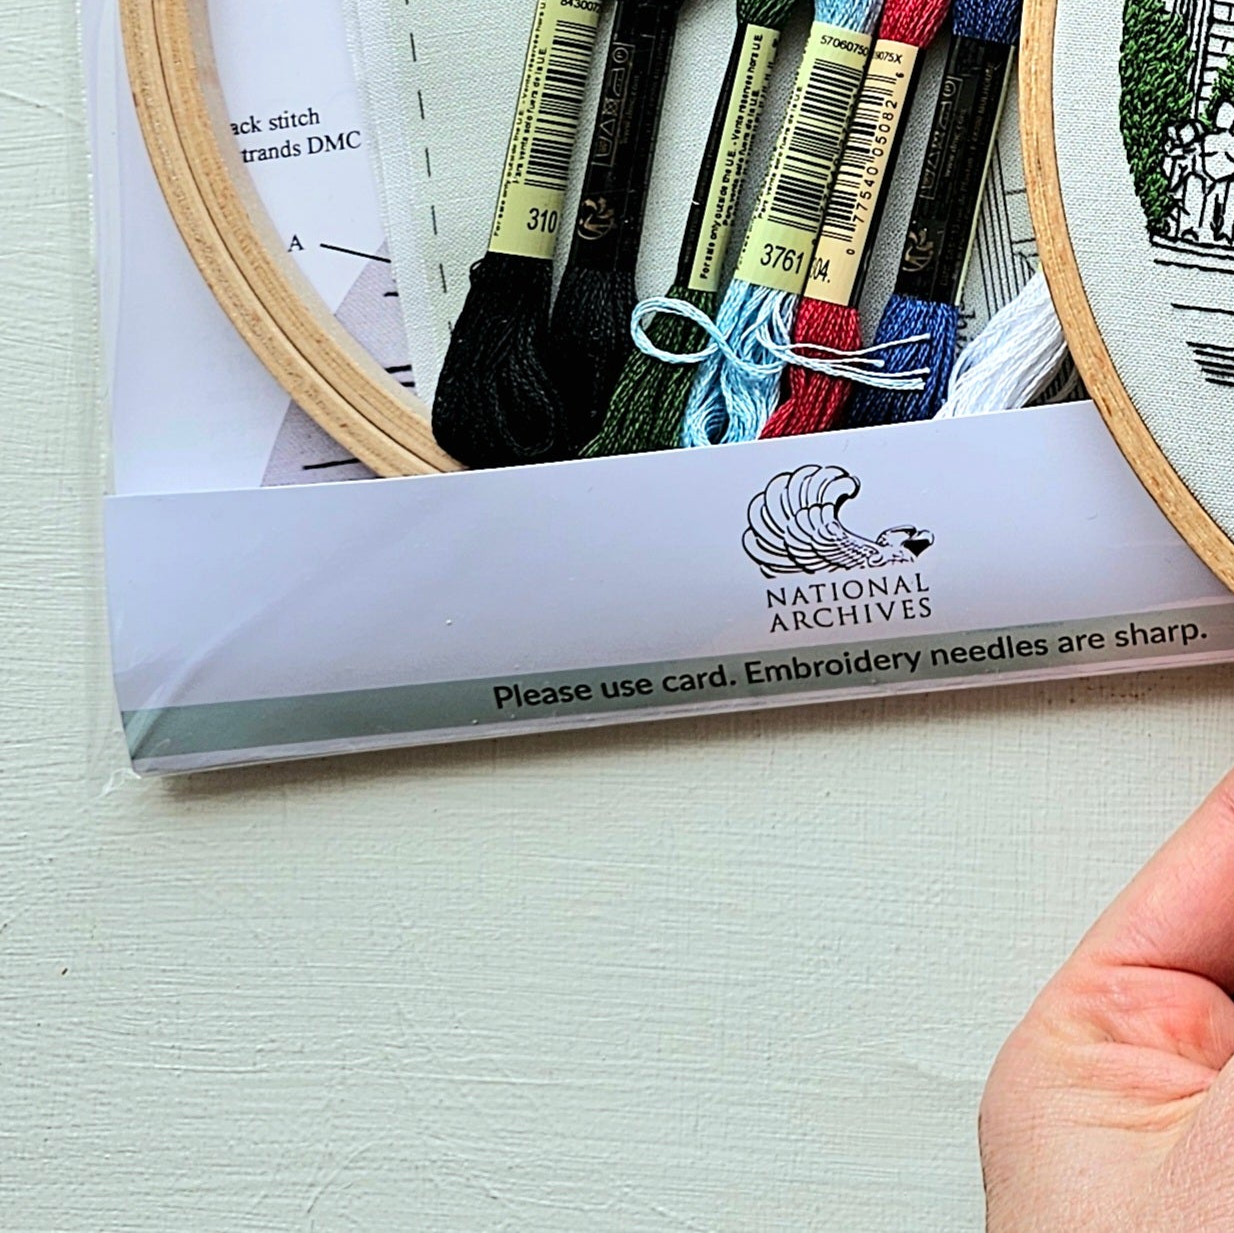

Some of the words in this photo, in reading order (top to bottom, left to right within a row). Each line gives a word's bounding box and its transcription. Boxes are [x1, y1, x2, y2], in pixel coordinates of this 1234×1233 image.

[269, 107, 321, 132] stitch
[241, 139, 302, 164] trands
[307, 130, 363, 156] DMC
[852, 167, 879, 225] 77540
[872, 99, 898, 157] 05082
[527, 206, 559, 235] 310
[287, 233, 305, 253] A
[760, 243, 805, 275] 3761
[766, 573, 930, 609] NATIONAL
[769, 597, 932, 634] ARCHIVES
[493, 683, 592, 710] Please
[601, 677, 654, 700] use
[662, 663, 737, 695] card.
[744, 648, 922, 686] Embroidery
[931, 635, 1049, 667] needles
[1058, 630, 1106, 655] are
[1115, 620, 1208, 649] sharp.
